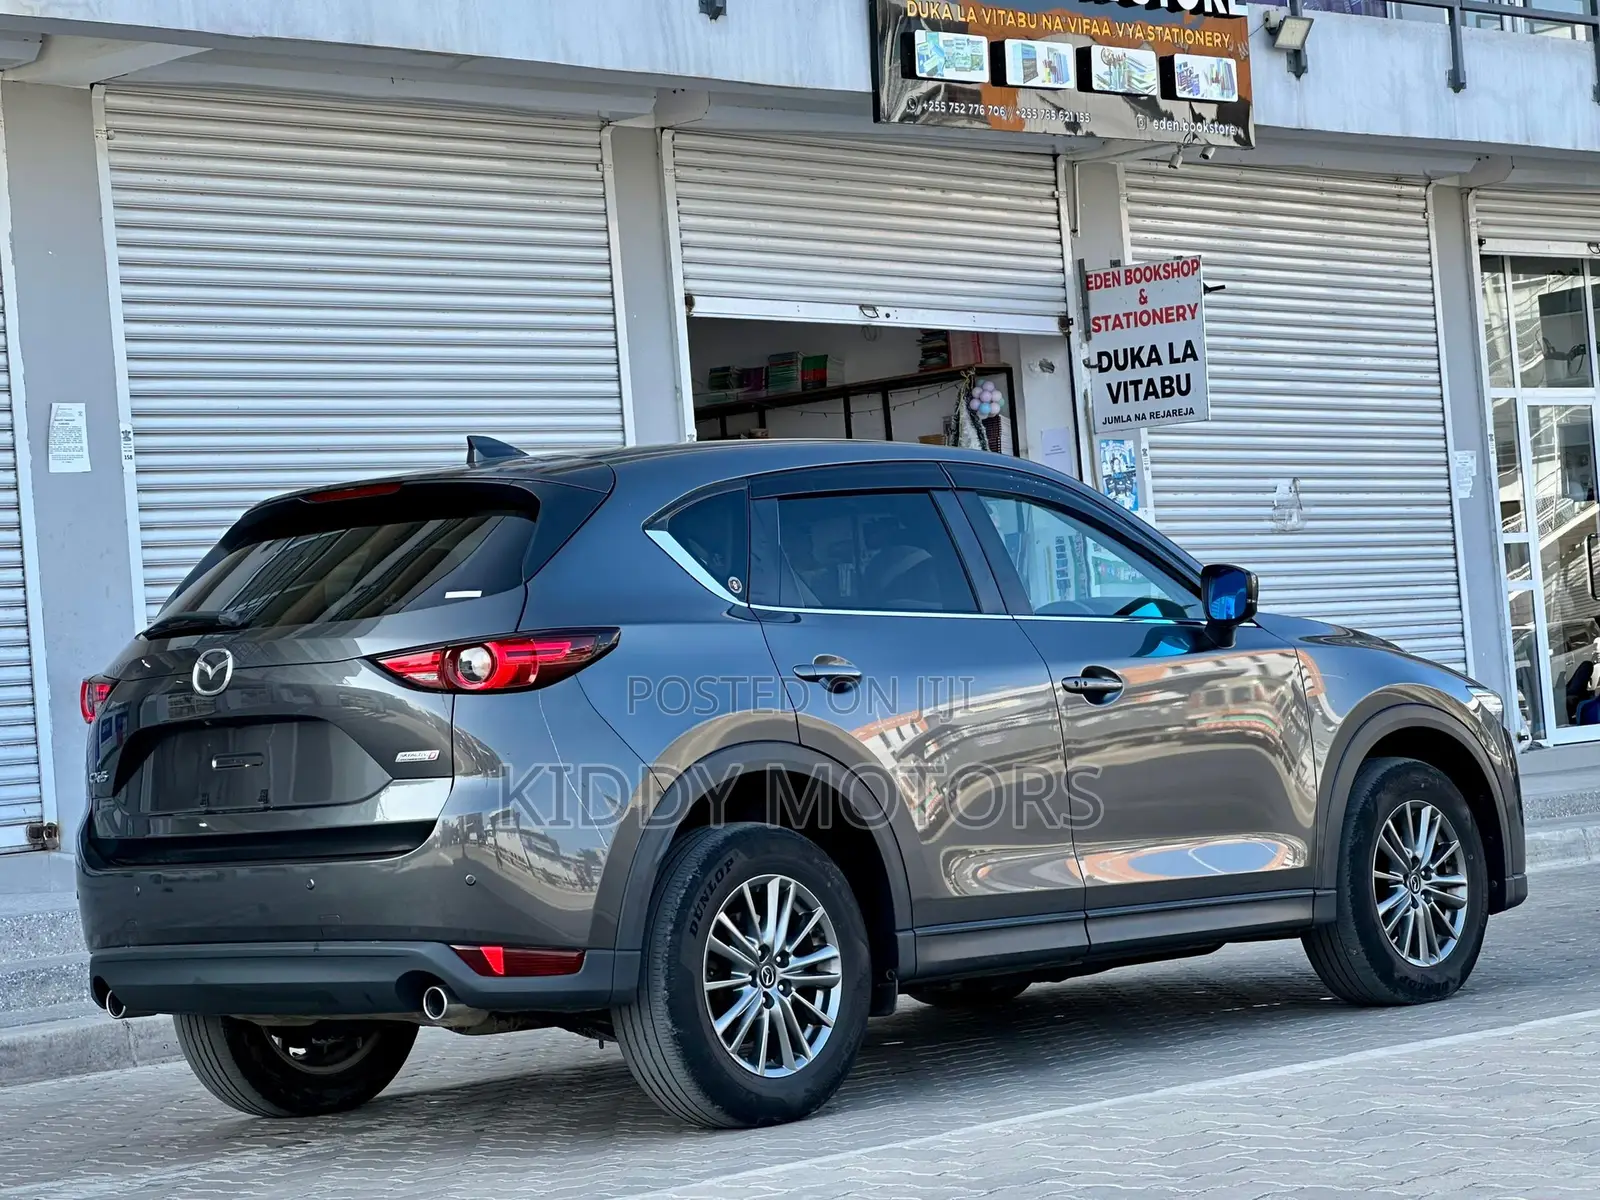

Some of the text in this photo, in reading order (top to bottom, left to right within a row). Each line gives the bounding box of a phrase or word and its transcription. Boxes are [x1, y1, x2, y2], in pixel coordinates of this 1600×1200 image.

[906, 0, 1231, 48] DUKA LA VITABU NA VIFAA VYA STATIONERY
[922, 101, 946, 113] +255
[949, 102, 966, 114] 752
[968, 103, 985, 115] 776
[988, 105, 1006, 117] 706
[1153, 118, 1237, 135] eden.bookstore
[1085, 259, 1200, 291] EDEN BOOKSHOP
[1138, 288, 1149, 305] &
[1091, 303, 1199, 333] STATIONERY
[1097, 340, 1199, 374] DUKA LA
[1106, 373, 1191, 404] VITABU
[1102, 407, 1195, 425] JUMLA NA REJAREJA
[689, 857, 735, 940] DUNLOP
